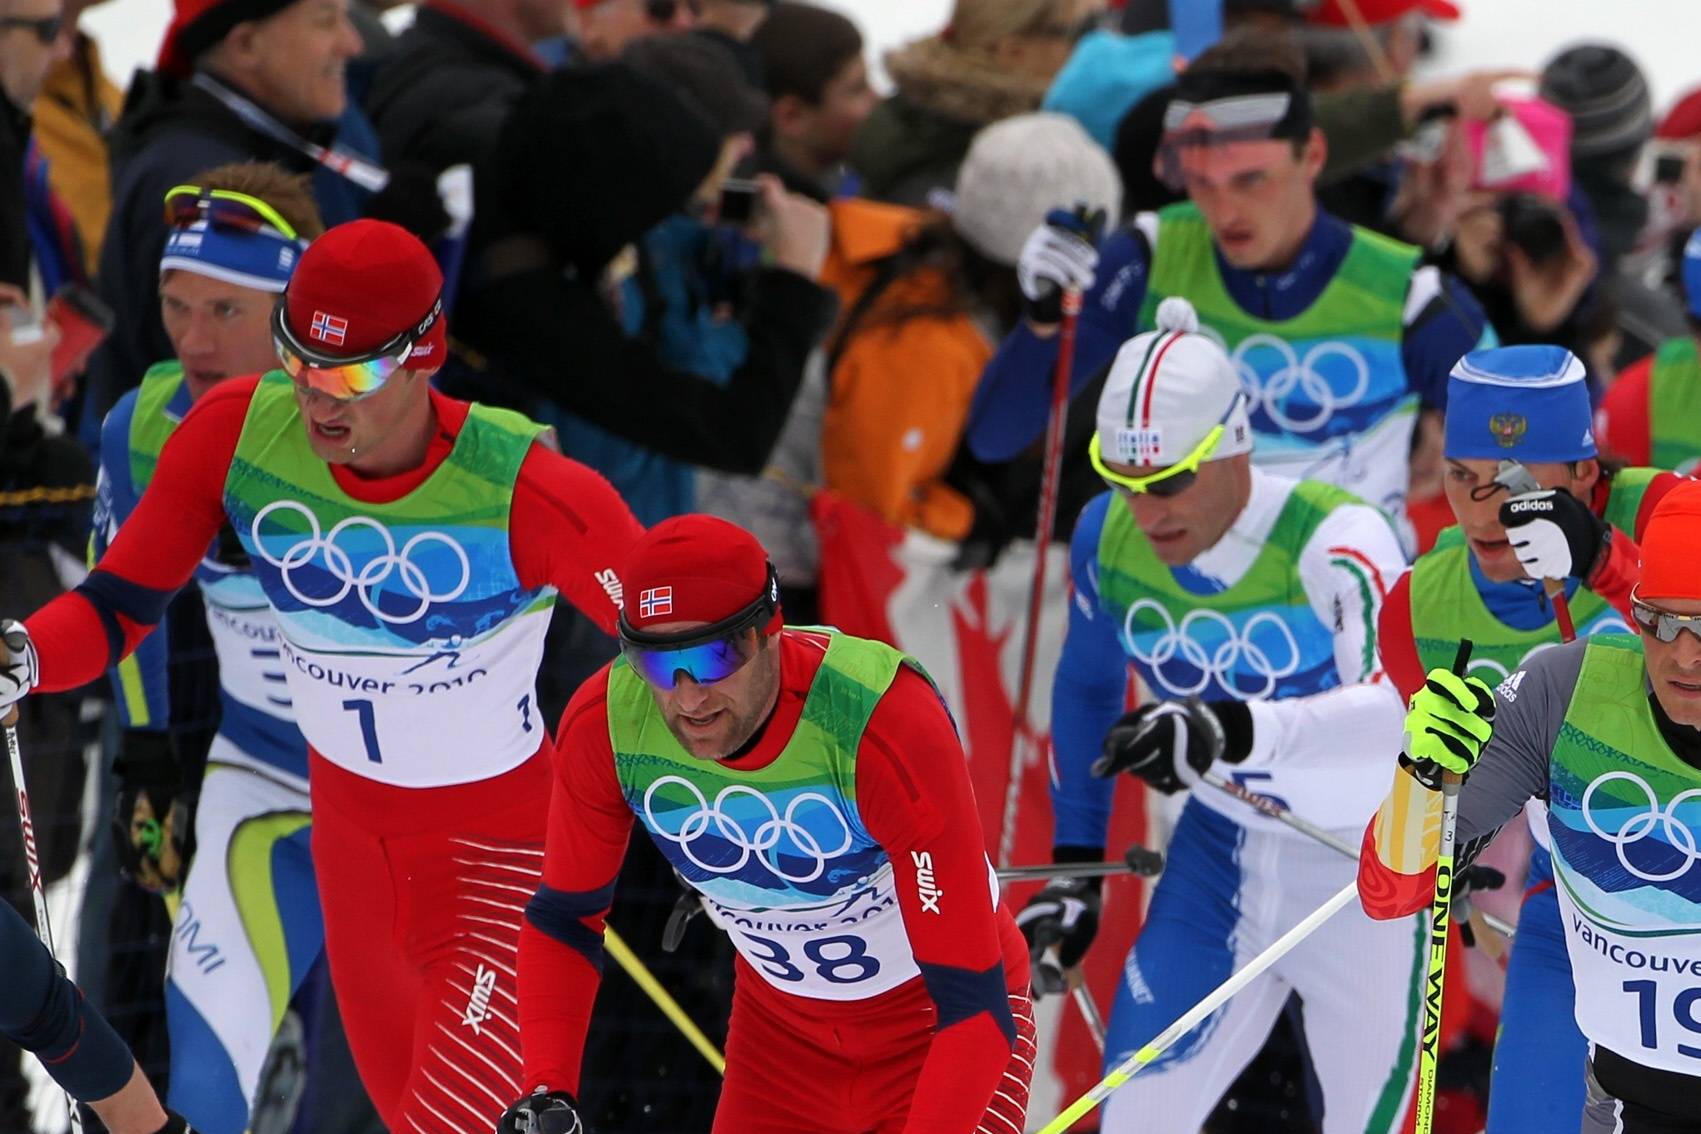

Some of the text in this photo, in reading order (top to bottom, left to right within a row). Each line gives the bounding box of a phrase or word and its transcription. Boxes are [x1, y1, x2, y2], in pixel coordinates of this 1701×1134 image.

[1510, 500, 1553, 513] adidas
[342, 699, 383, 764] 1
[741, 931, 881, 984] 38
